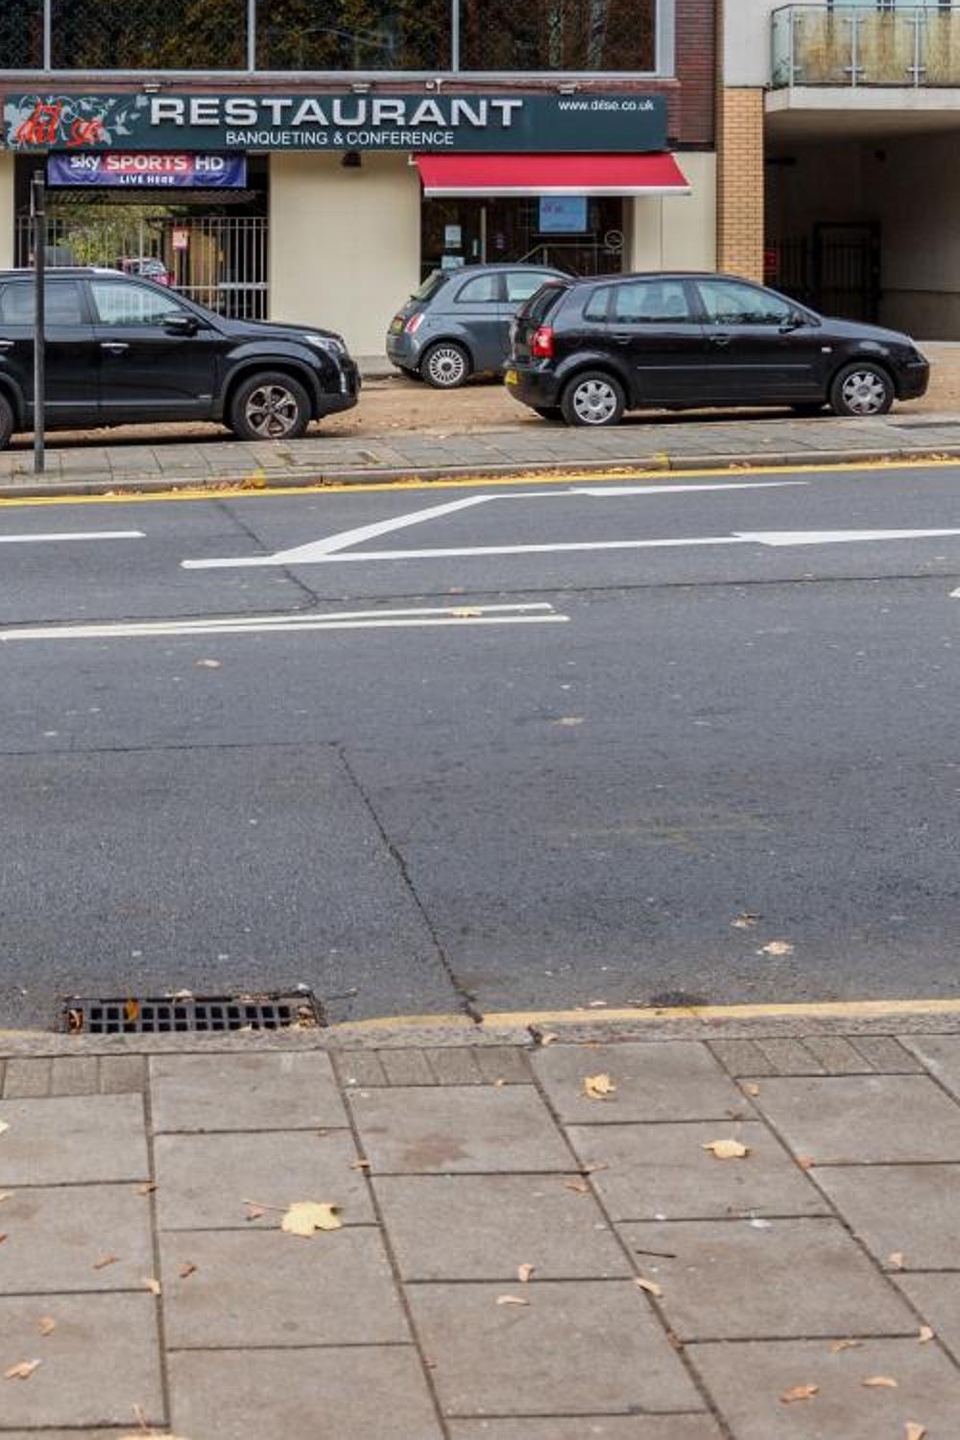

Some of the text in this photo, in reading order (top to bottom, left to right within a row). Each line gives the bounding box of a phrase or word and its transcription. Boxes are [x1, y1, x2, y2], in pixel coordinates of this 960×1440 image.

[150, 97, 523, 127] RESTAURANT
[557, 99, 655, 111] www.dilse.co.uk
[225, 131, 455, 145] BANQUETING & CONFERENCE
[70, 153, 225, 172] sky SPORTS HD
[119, 173, 175, 185] LIVE HERE
